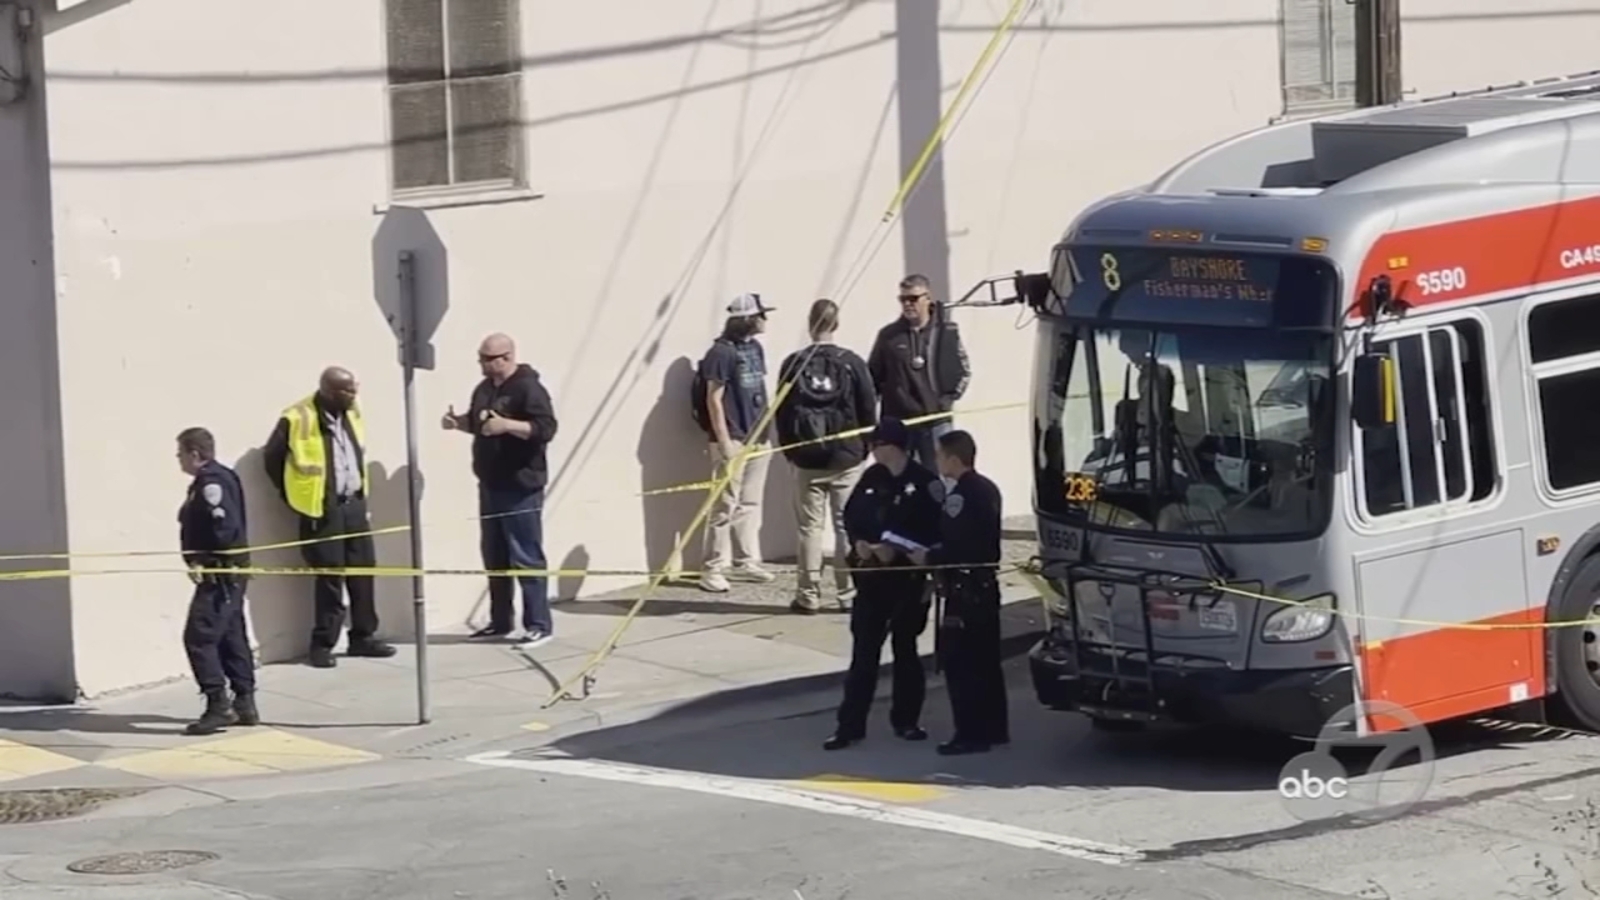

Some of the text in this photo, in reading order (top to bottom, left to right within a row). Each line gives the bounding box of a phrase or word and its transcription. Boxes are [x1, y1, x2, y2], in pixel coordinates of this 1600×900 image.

[1100, 252, 1121, 291] 8
[1169, 256, 1247, 281] BAYSHORE
[1144, 279, 1233, 300] Fisherman's
